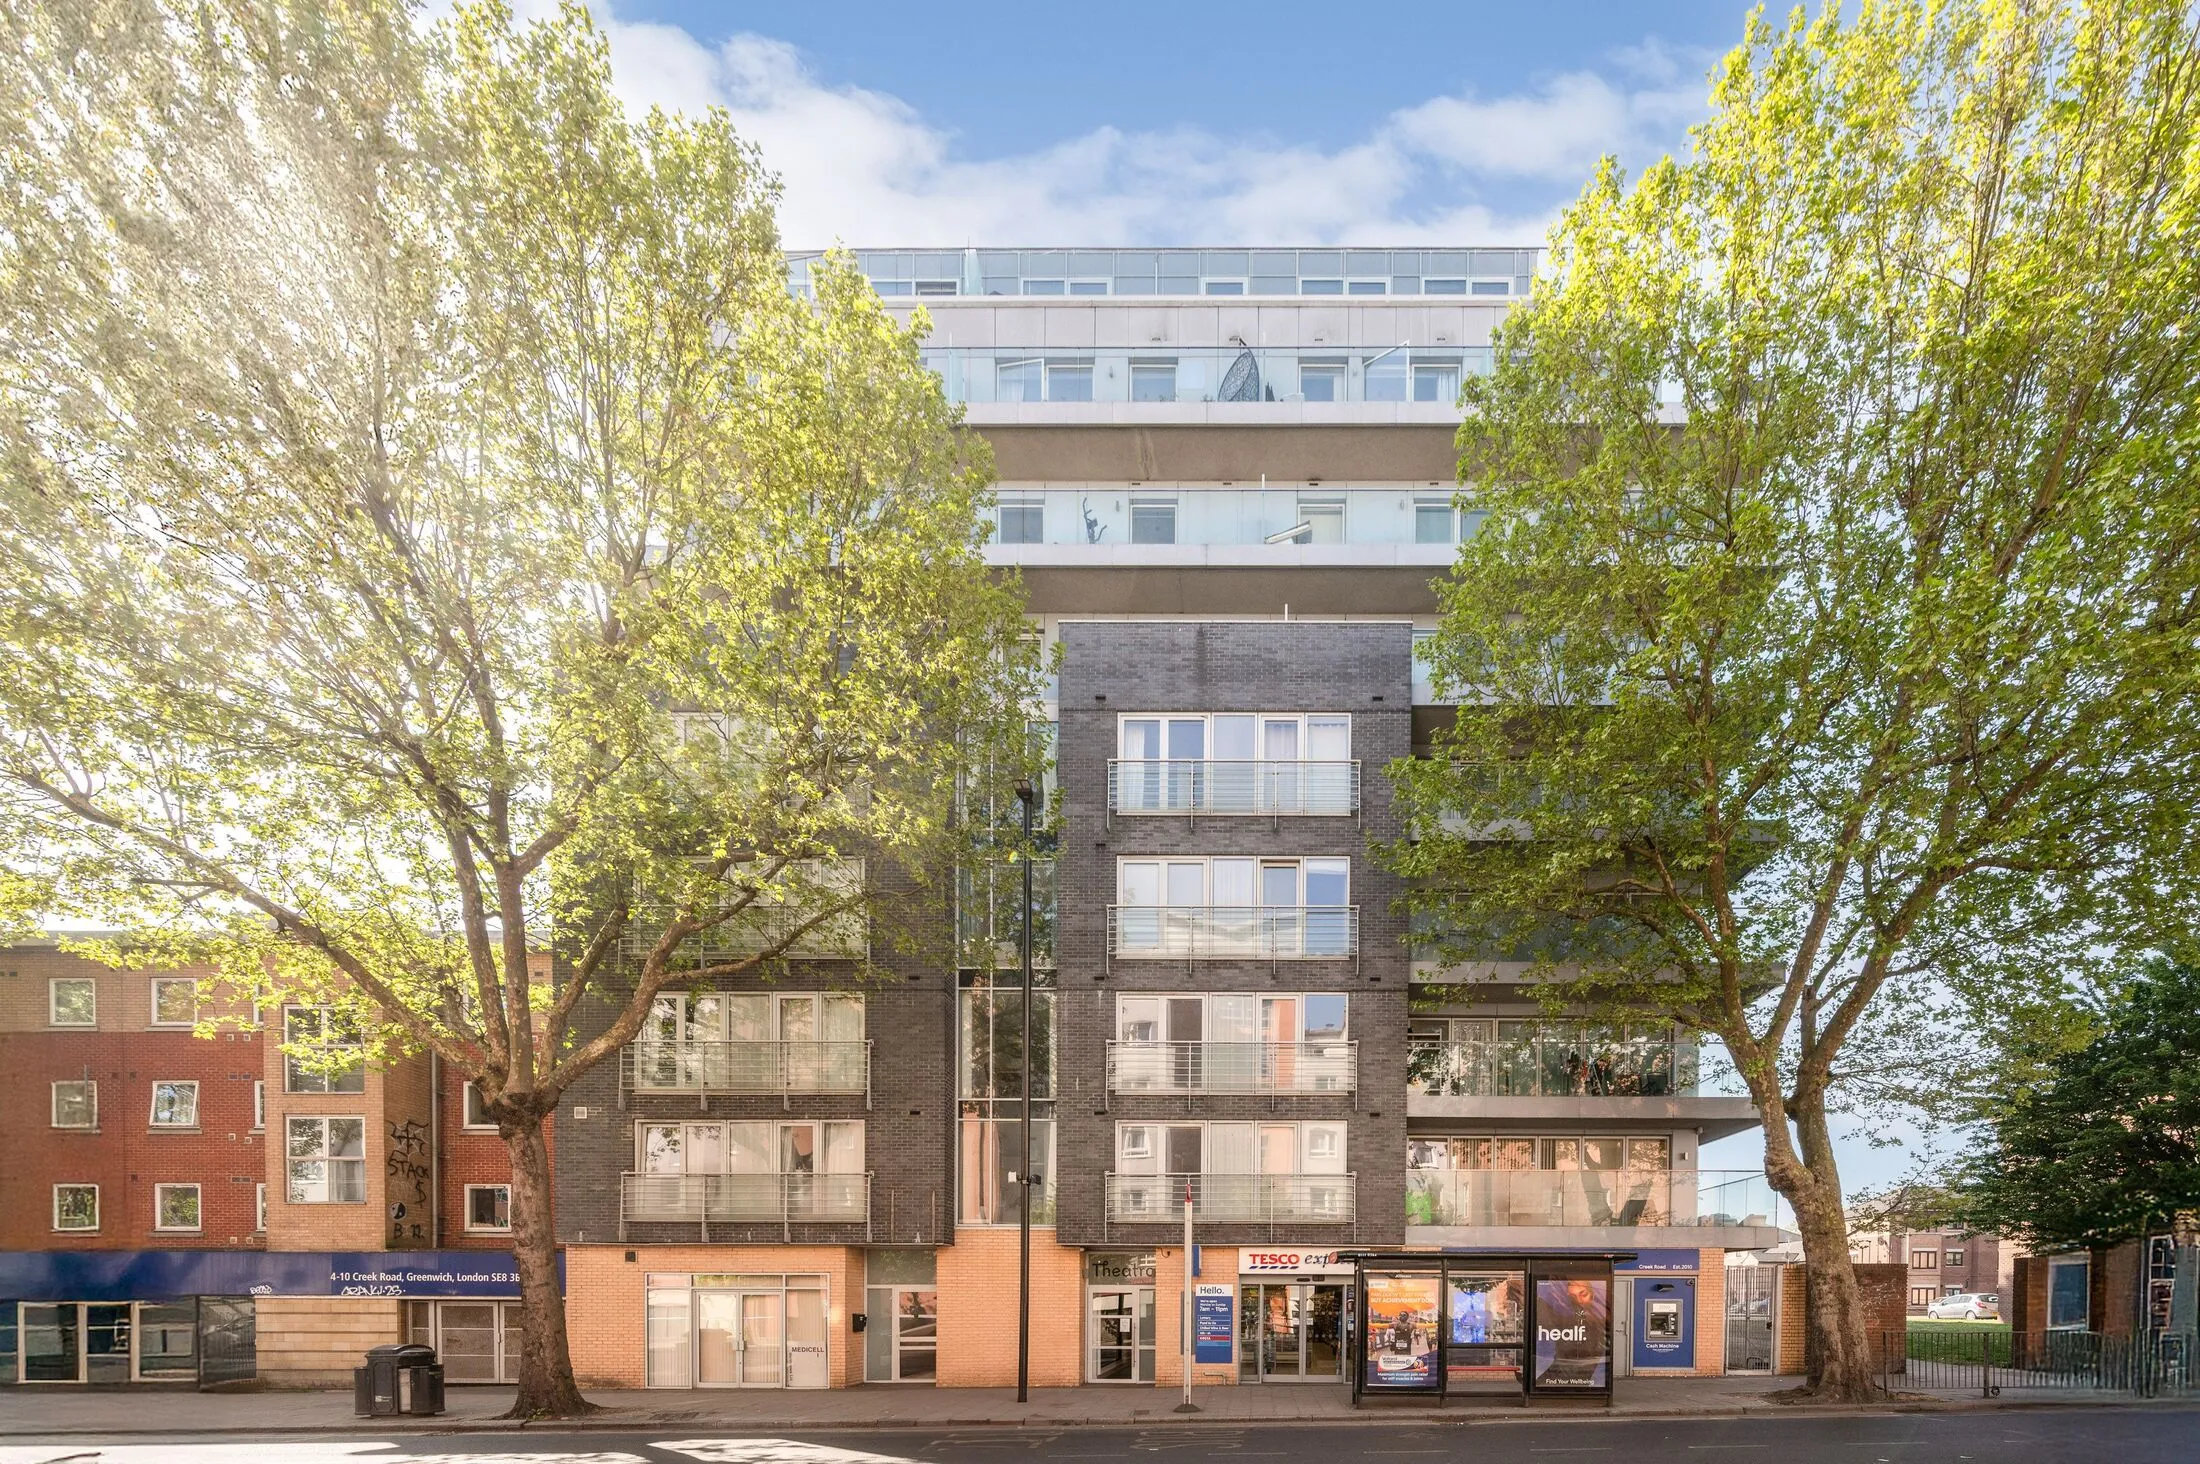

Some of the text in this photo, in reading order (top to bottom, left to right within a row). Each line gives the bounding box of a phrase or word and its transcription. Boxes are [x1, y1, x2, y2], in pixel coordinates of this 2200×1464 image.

[1249, 1254, 1300, 1265] TESCO
[330, 1272, 351, 1282] 4-10
[352, 1272, 378, 1282] Creek
[379, 1272, 405, 1283] Road,
[406, 1272, 455, 1283] Greenwich,
[456, 1272, 489, 1282] London
[491, 1272, 508, 1282] SE8
[1200, 1286, 1225, 1294] Hello.
[1538, 1325, 1587, 1341] healf.
[1569, 1378, 1595, 1386] Wellbeing
